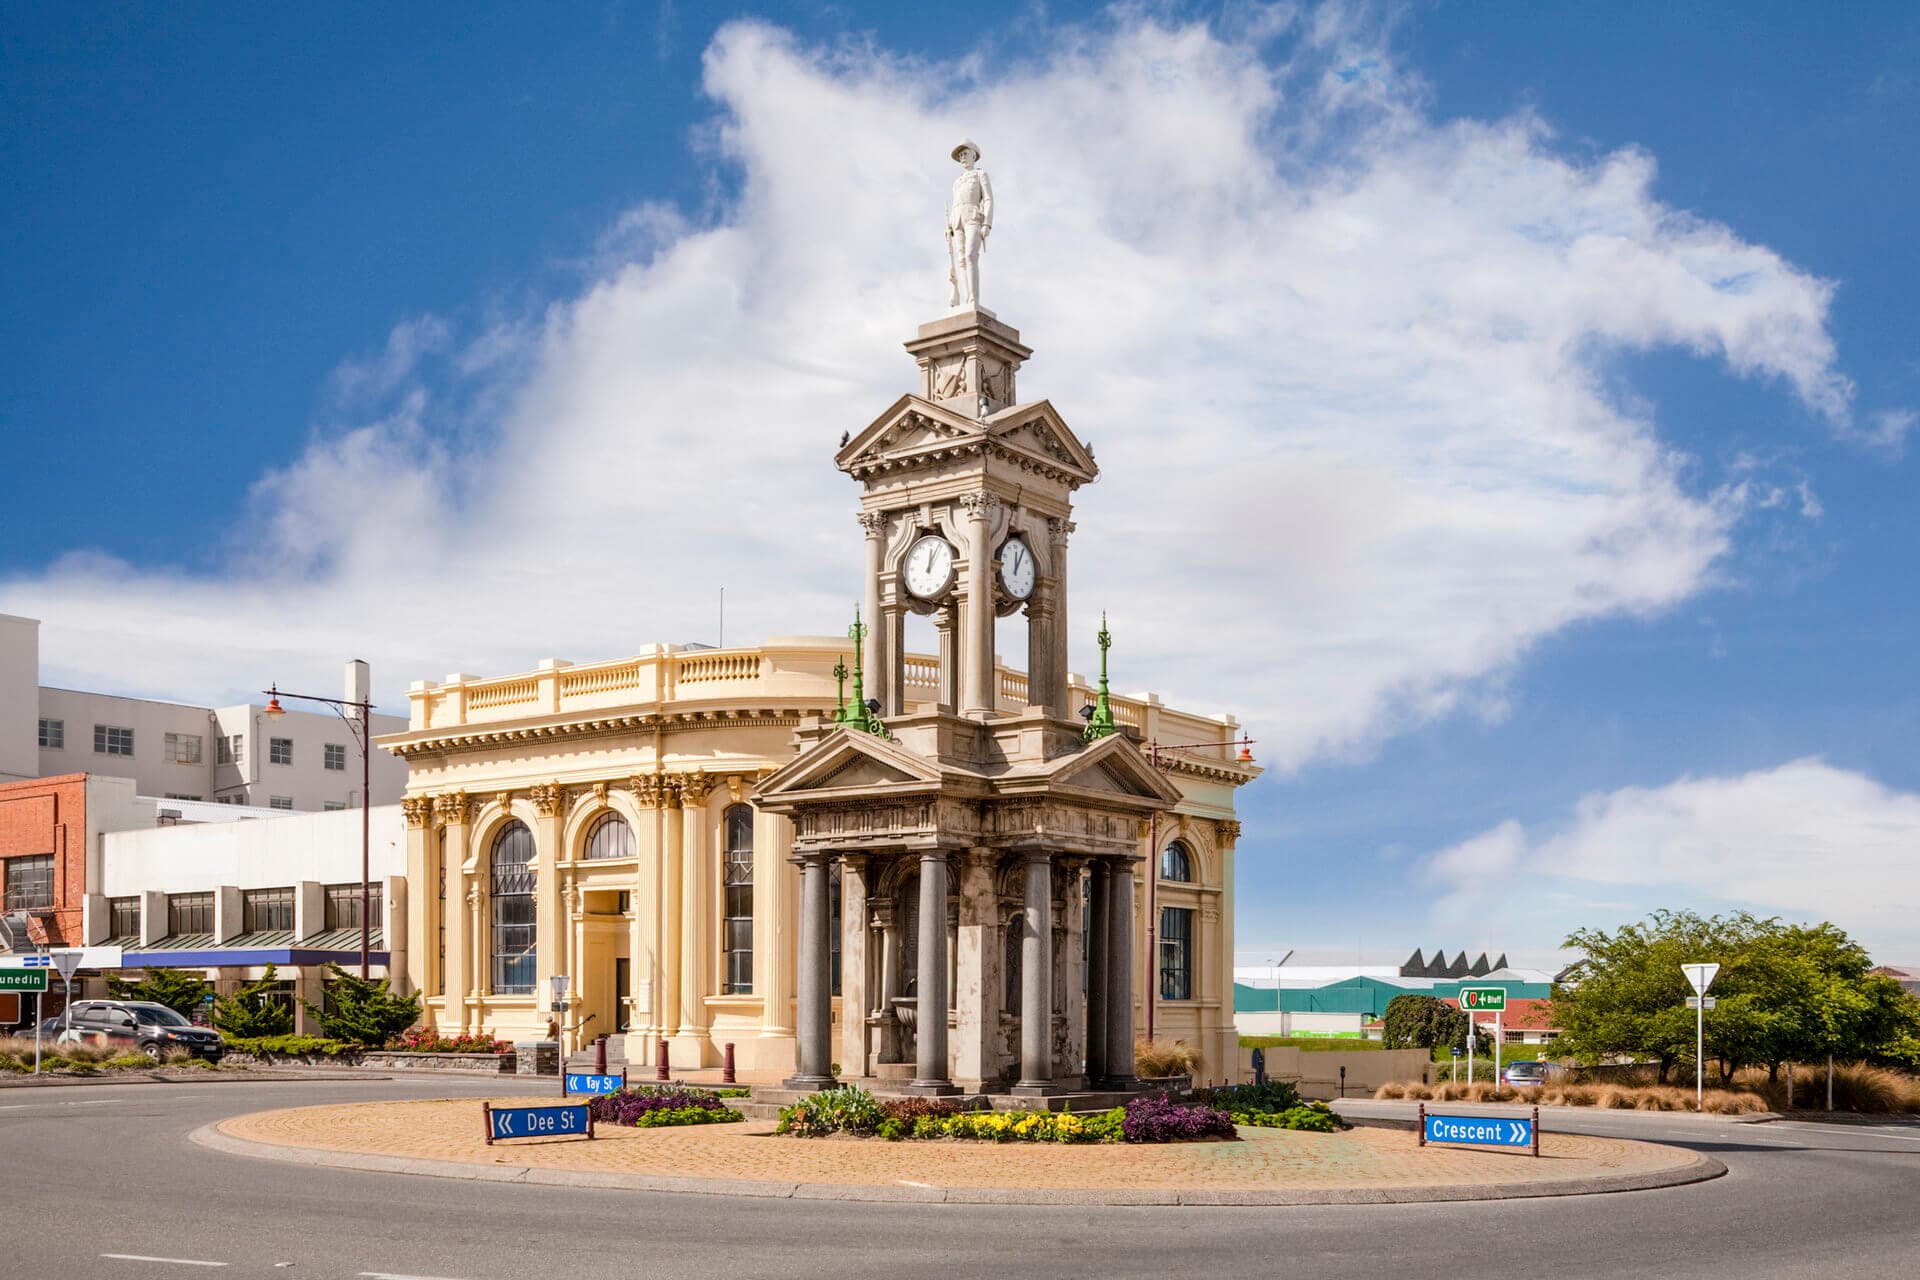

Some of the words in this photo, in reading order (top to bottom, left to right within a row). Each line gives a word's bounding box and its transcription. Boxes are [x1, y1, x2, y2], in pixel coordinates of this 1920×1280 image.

[586, 1076, 600, 1092] Tay
[603, 1076, 612, 1090] St
[527, 1113, 555, 1131] Dee
[561, 1111, 575, 1129] St
[1433, 1119, 1502, 1140] Crescent
